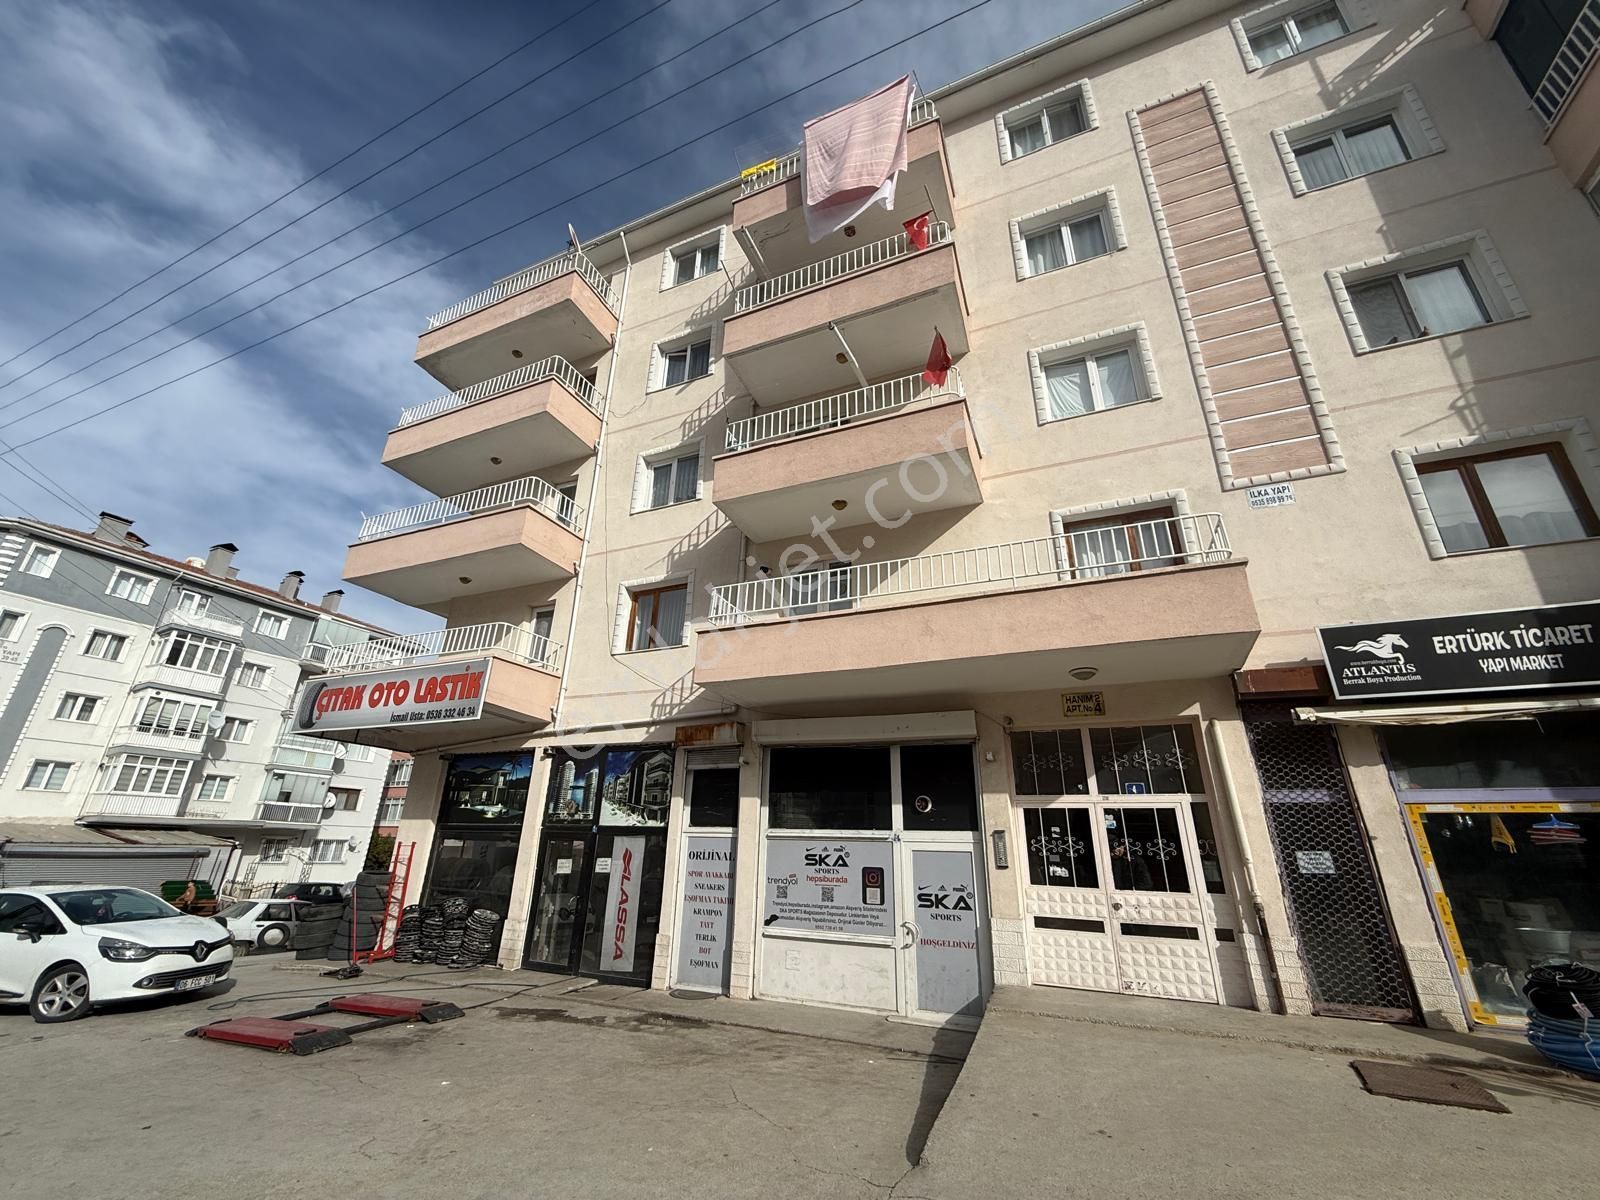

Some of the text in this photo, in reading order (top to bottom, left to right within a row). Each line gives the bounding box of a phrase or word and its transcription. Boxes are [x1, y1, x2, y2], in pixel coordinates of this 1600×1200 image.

[1270, 485, 1290, 495] YAPI
[1432, 623, 1594, 655] ERTÜRK TİCARET
[1478, 653, 1565, 674] YAPI MARKET
[1342, 663, 1416, 678] ATLANTIS
[1343, 674, 1422, 685] Berrak Boya Production
[316, 664, 484, 720] ÇITAK OTO LASTİK
[1065, 694, 1100, 704] HANIM 2
[1094, 702, 1102, 712] 4
[410, 711, 424, 722] Usta:
[426, 710, 442, 721] 0536
[443, 708, 456, 719] 332
[466, 706, 476, 717] 34
[688, 848, 735, 862] ORİJİNAL
[804, 854, 849, 868] SKA
[688, 870, 704, 878] SPOR
[806, 874, 848, 884] hepsiburada
[768, 876, 798, 886] trendyol
[694, 883, 725, 892] SNEAKERS
[917, 892, 973, 911] SKA
[613, 873, 631, 960] LASSA
[693, 907, 723, 917] KRAMPON
[930, 913, 962, 921] SPORTS
[700, 921, 714, 929] TAYT
[695, 933, 717, 942] TERLİK
[920, 938, 976, 950] HOŞGELDİNİZ
[699, 946, 712, 955] BOT
[689, 959, 719, 969] EŞOFMAN
